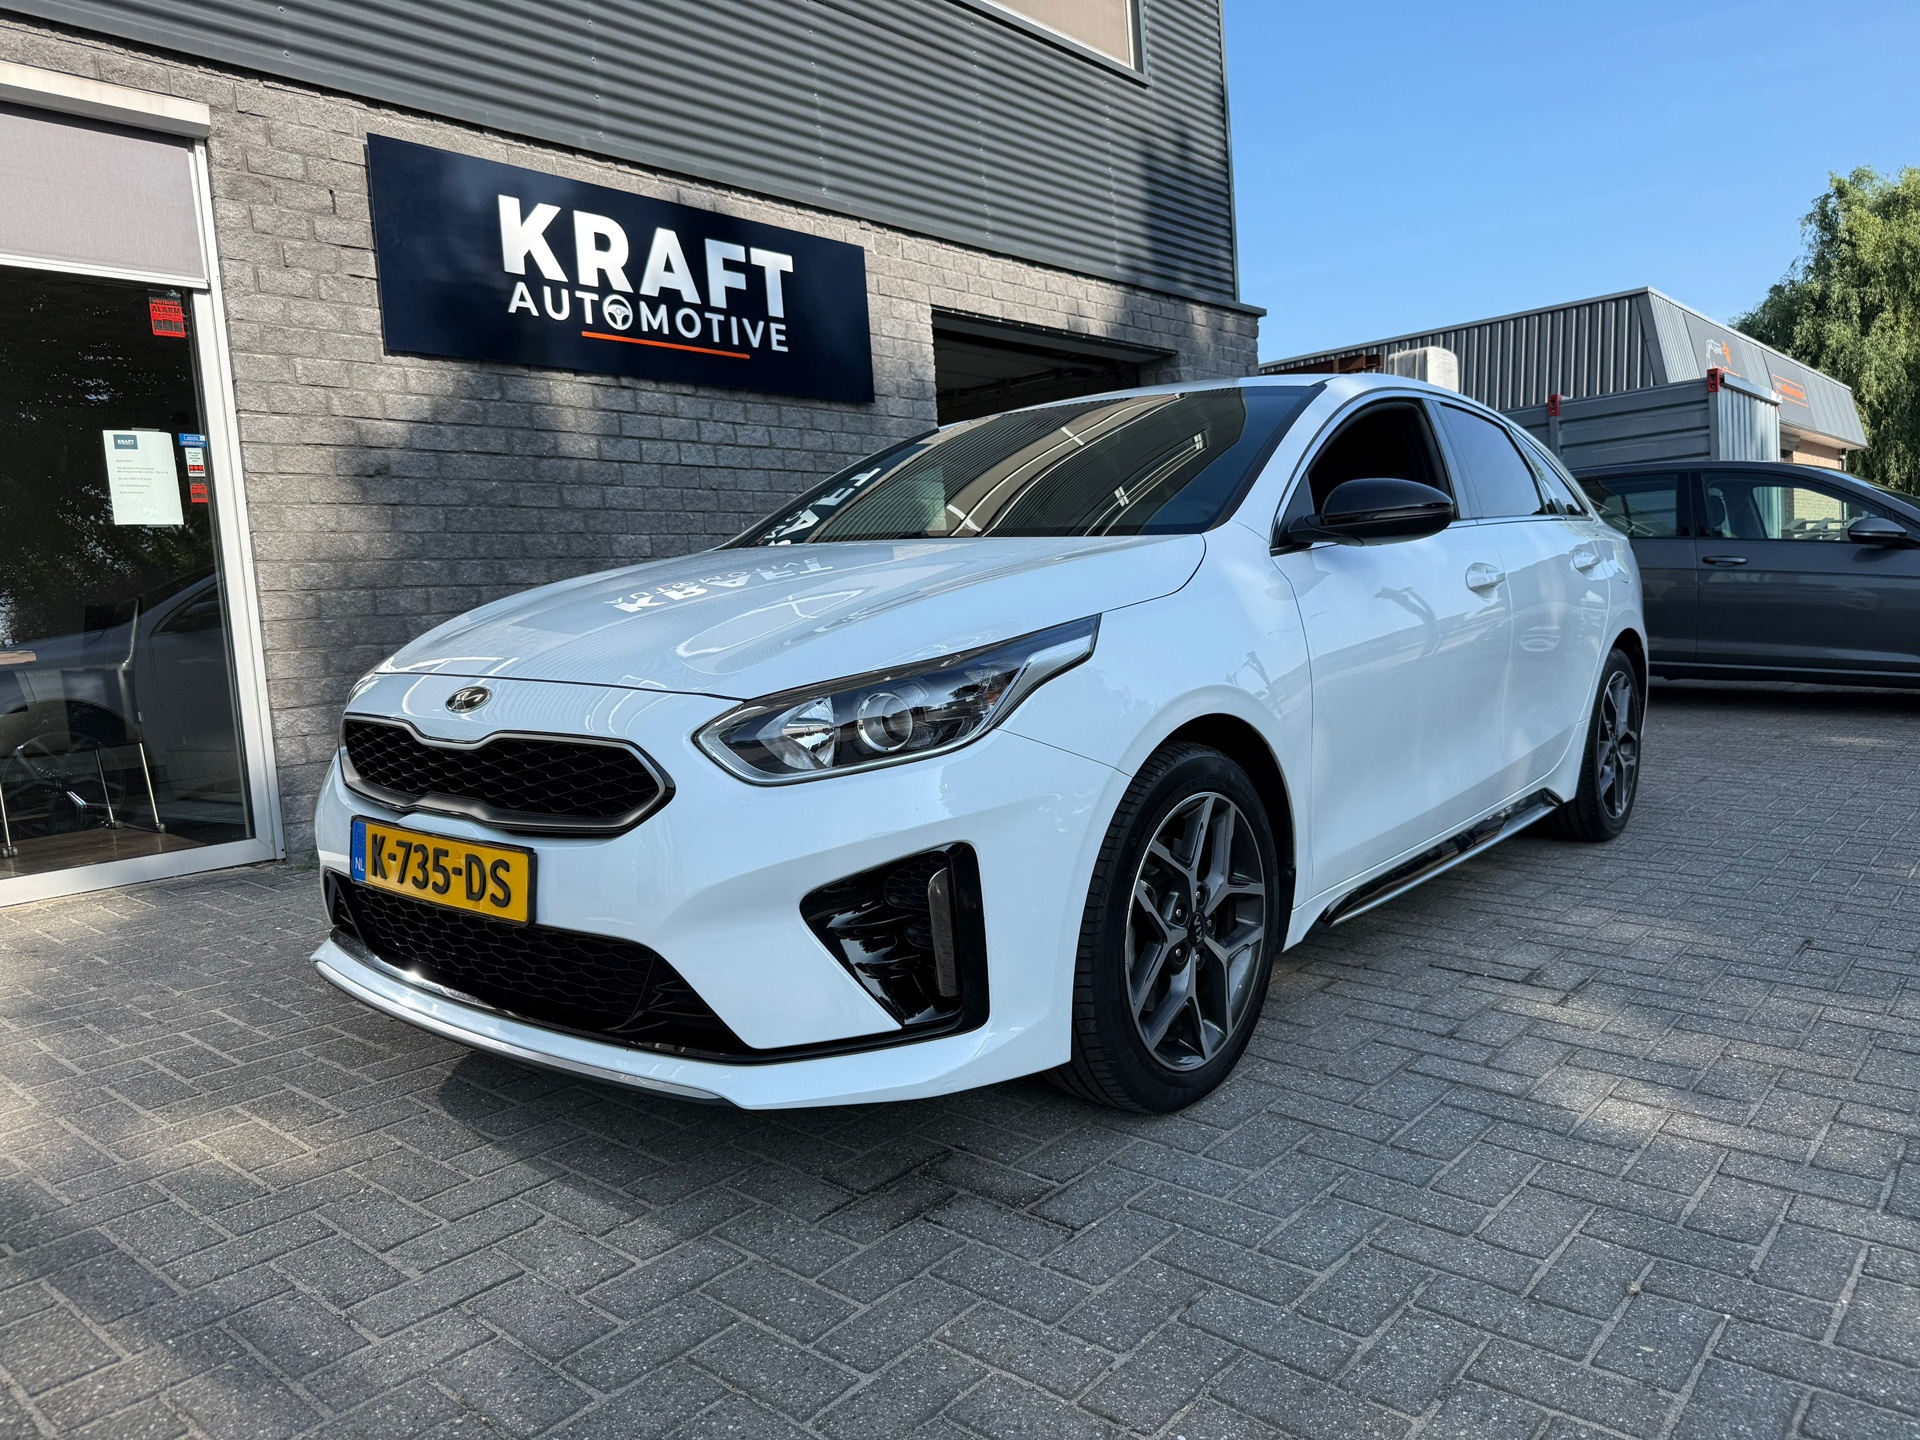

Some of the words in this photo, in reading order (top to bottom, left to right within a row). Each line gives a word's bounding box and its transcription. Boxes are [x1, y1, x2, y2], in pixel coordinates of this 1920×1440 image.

[498, 194, 794, 319] KRAFT
[152, 305, 181, 315] ALARM
[508, 281, 789, 353] AUTOMOTIVE
[355, 856, 365, 872] NL
[371, 833, 512, 908] K-735-DS
